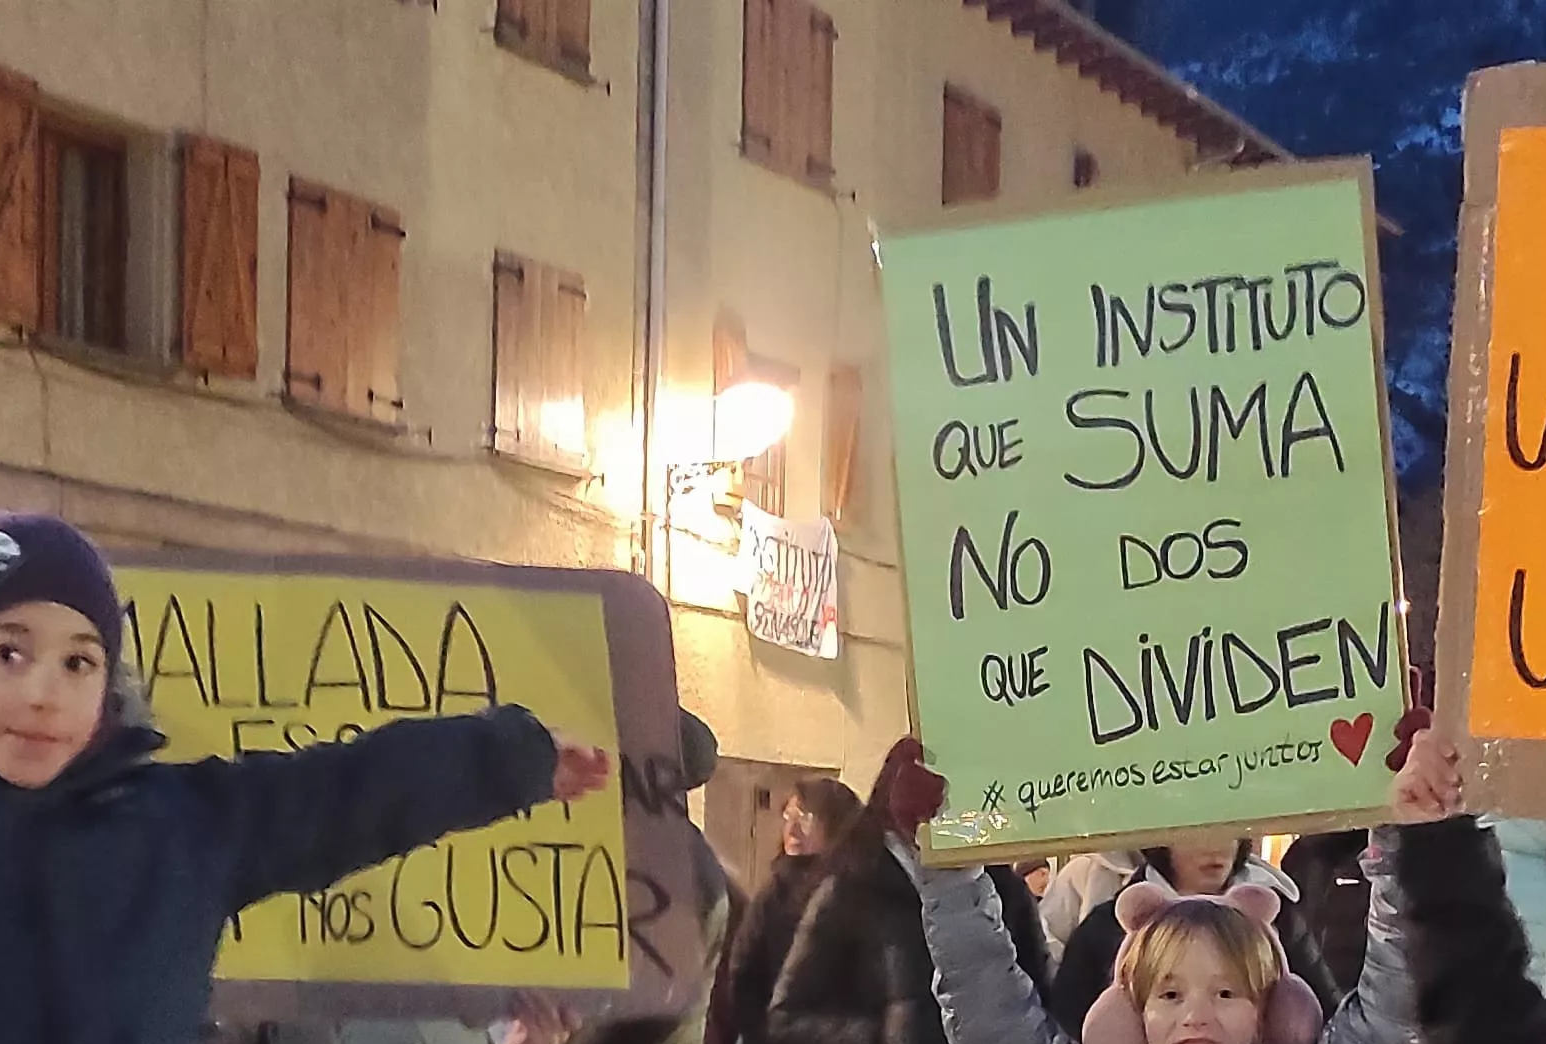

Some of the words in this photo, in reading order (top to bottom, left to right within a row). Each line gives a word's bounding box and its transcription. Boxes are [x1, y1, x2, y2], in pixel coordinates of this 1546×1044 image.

[933, 274, 1039, 387] UN
[1089, 258, 1366, 368] INSTITUTO
[933, 418, 1023, 480] QUE
[1063, 372, 1344, 490] SUMA
[949, 510, 1052, 620] NO
[1118, 518, 1249, 590] DOS
[980, 646, 1050, 706] QUE
[390, 841, 625, 962] GUSTA
